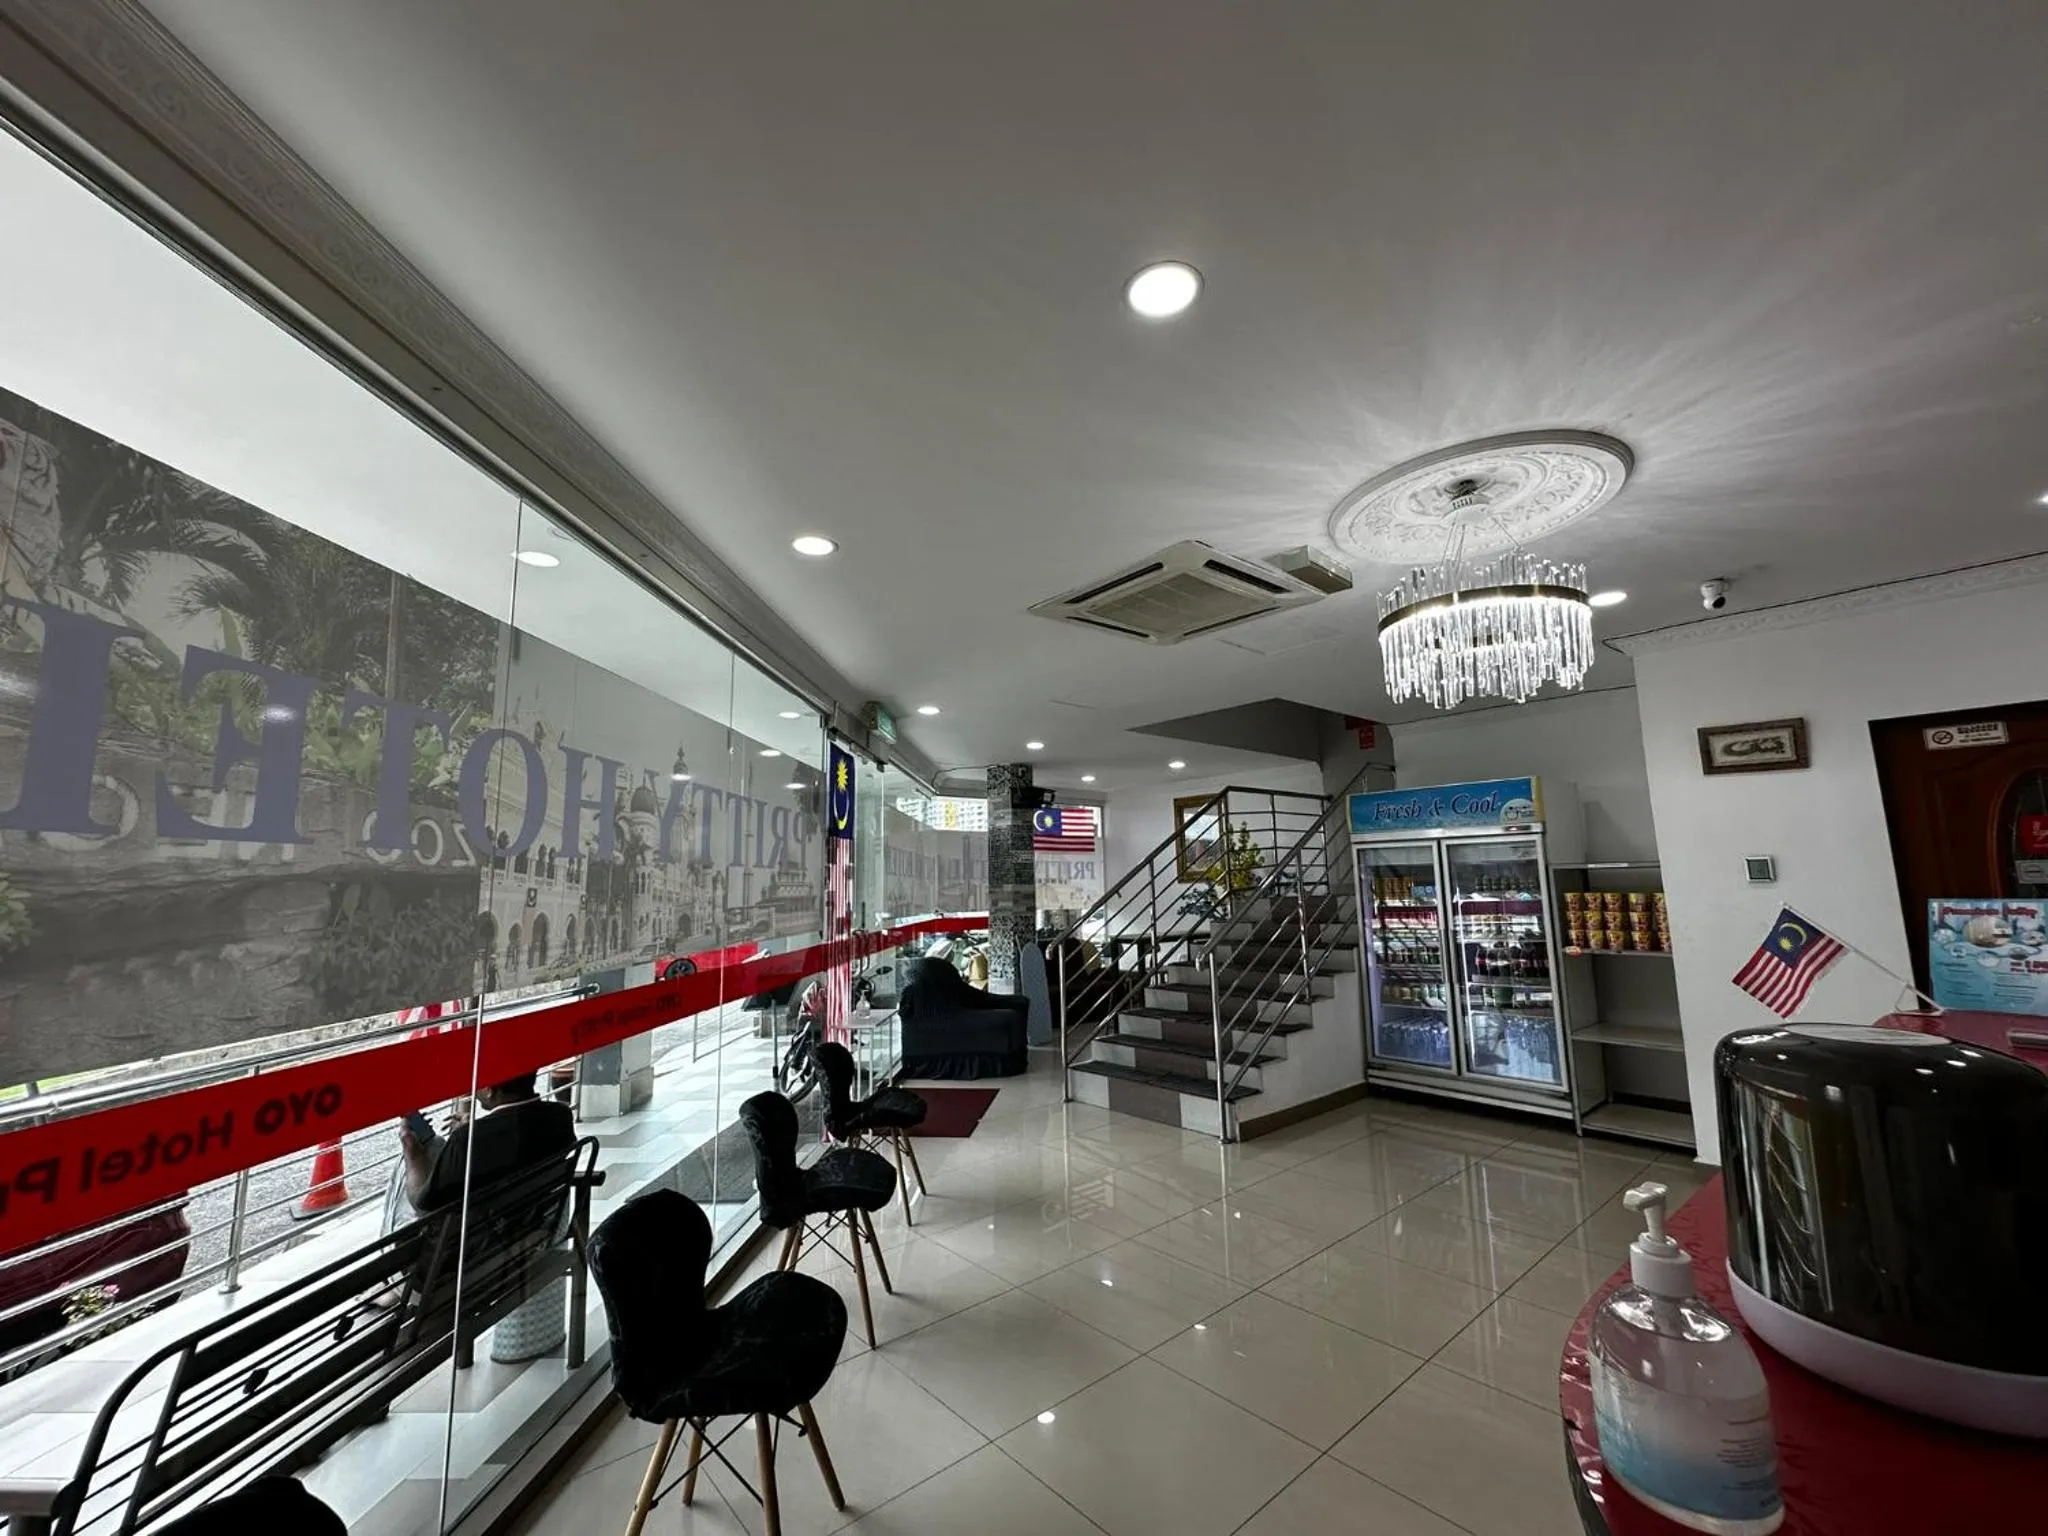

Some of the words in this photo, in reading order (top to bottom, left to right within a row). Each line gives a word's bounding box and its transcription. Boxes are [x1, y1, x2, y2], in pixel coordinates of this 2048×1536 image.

[1373, 797, 1422, 820] Fresh
[1429, 796, 1444, 817] &
[1451, 790, 1499, 816] Cool
